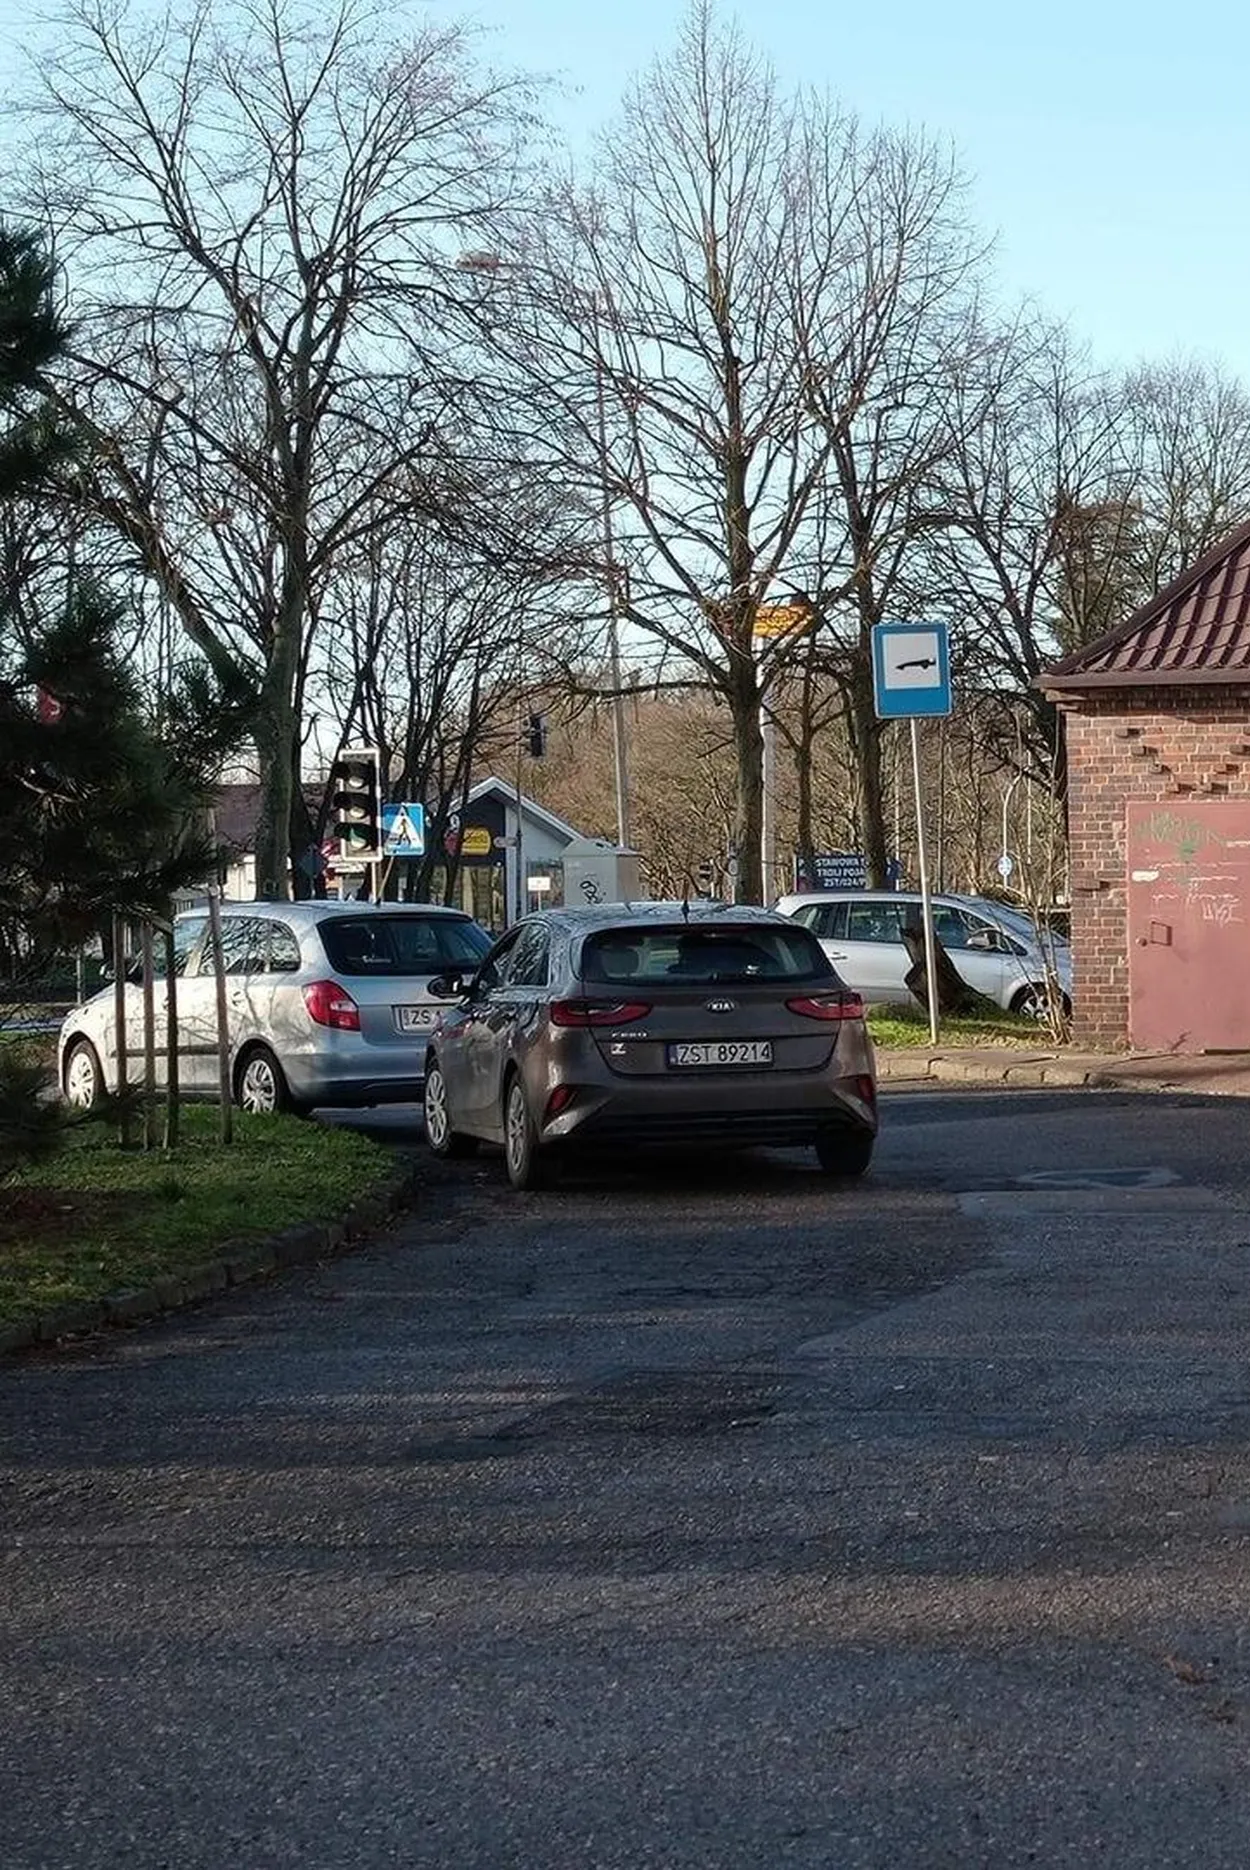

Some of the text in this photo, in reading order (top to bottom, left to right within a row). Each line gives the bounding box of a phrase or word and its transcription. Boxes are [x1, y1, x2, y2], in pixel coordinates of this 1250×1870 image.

[711, 1003, 731, 1012] KIA
[678, 1043, 772, 1064] ZST 89214
